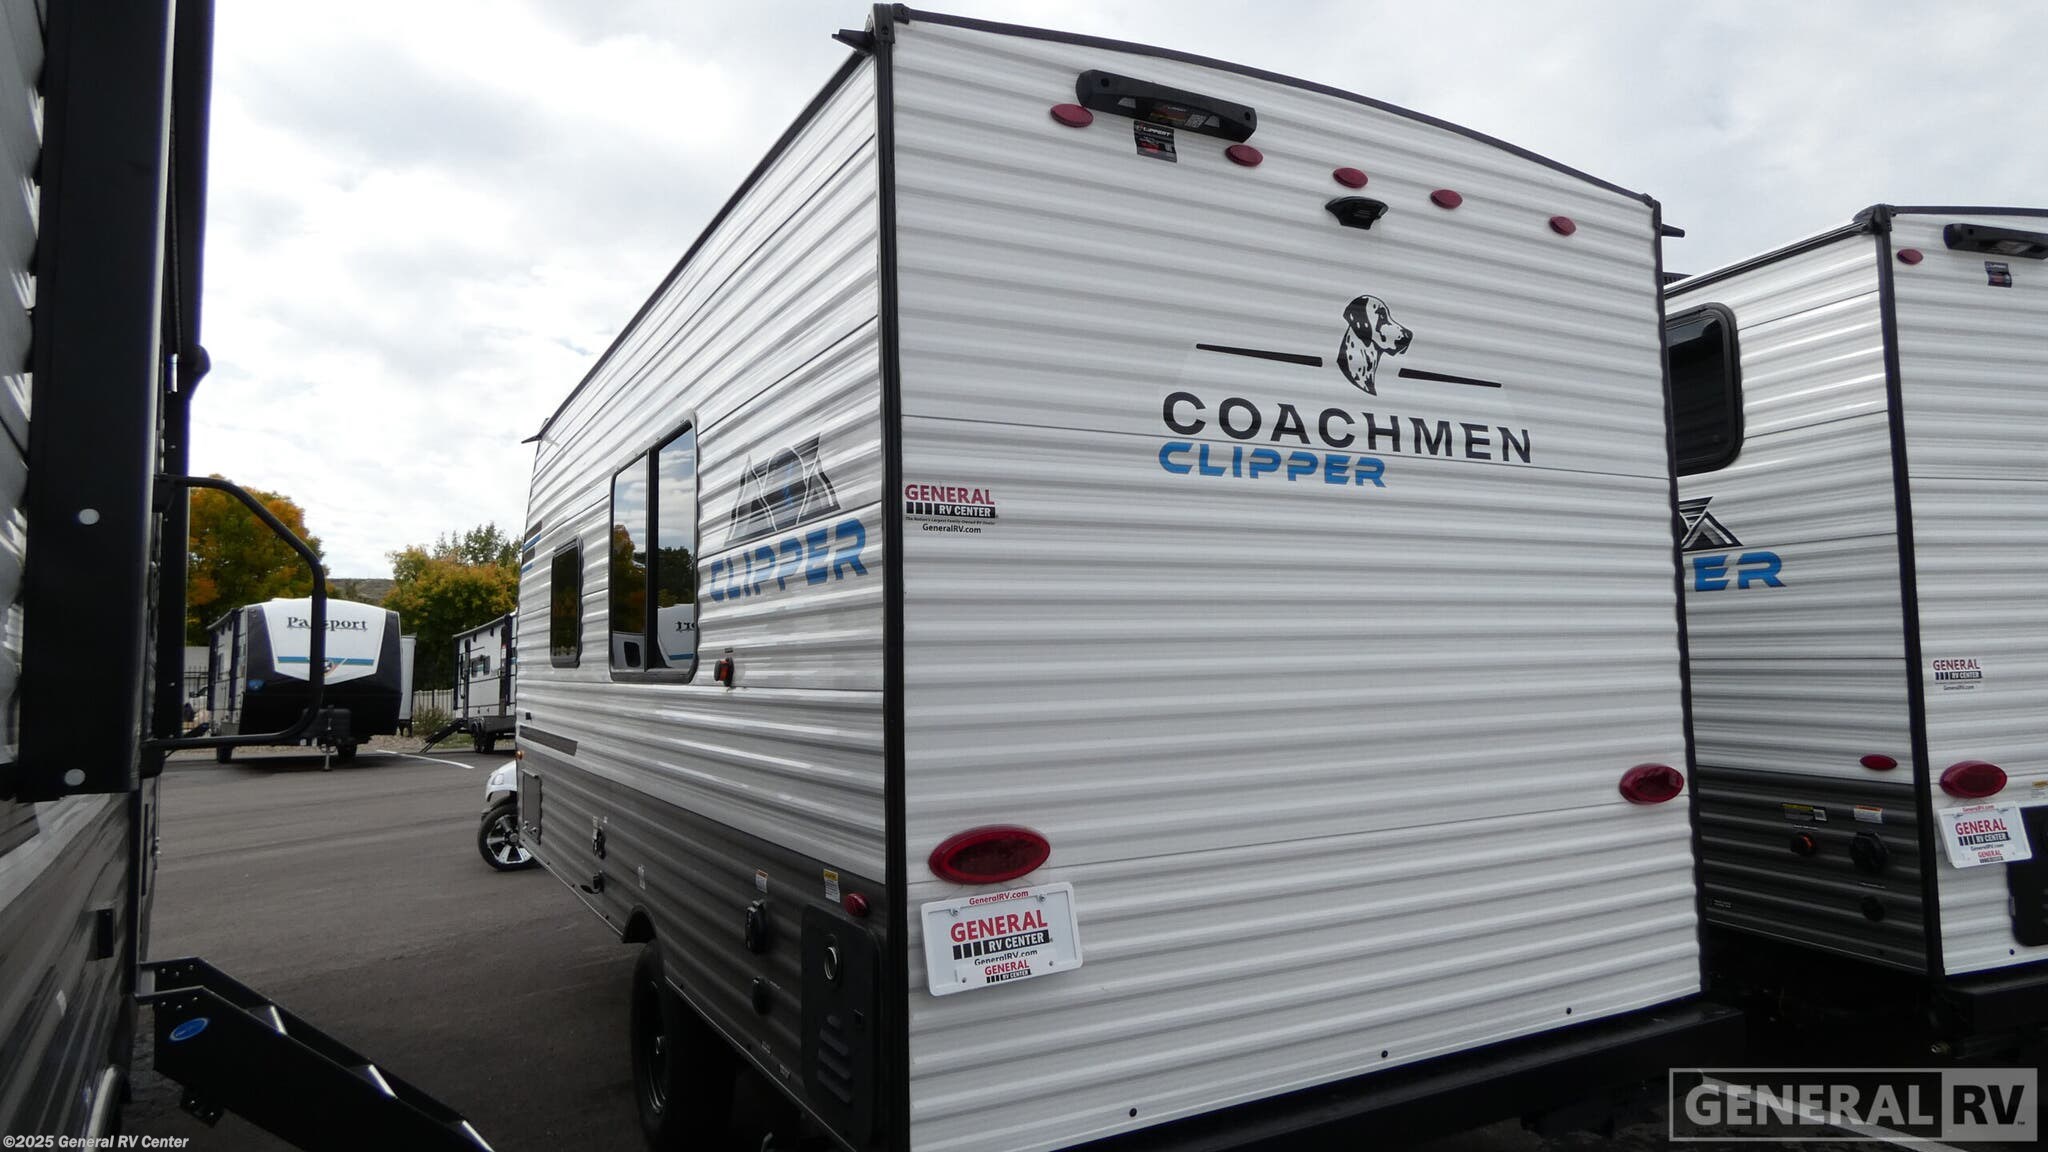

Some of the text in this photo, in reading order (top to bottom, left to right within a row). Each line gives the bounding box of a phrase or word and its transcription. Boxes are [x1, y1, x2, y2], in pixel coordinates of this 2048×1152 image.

[1163, 391, 1532, 464] COACHMEN
[1158, 441, 1386, 488] CLIPPER
[905, 484, 995, 505] GENERAL
[939, 505, 992, 517] RV CENTER
[922, 523, 982, 534] GeneralRV.com
[710, 517, 868, 603] CLIPPER
[287, 616, 368, 632] Paport
[1933, 659, 1980, 671] GENERAL
[1955, 818, 2007, 836] GENERAL
[1978, 849, 2002, 858] GENERAL
[969, 890, 1029, 906] GeneralRV.com
[951, 909, 1048, 943] GENERAL
[988, 932, 1045, 953] RV CENTER
[974, 949, 1038, 966] GeneralRV.com
[985, 959, 1030, 976] GENERAL
